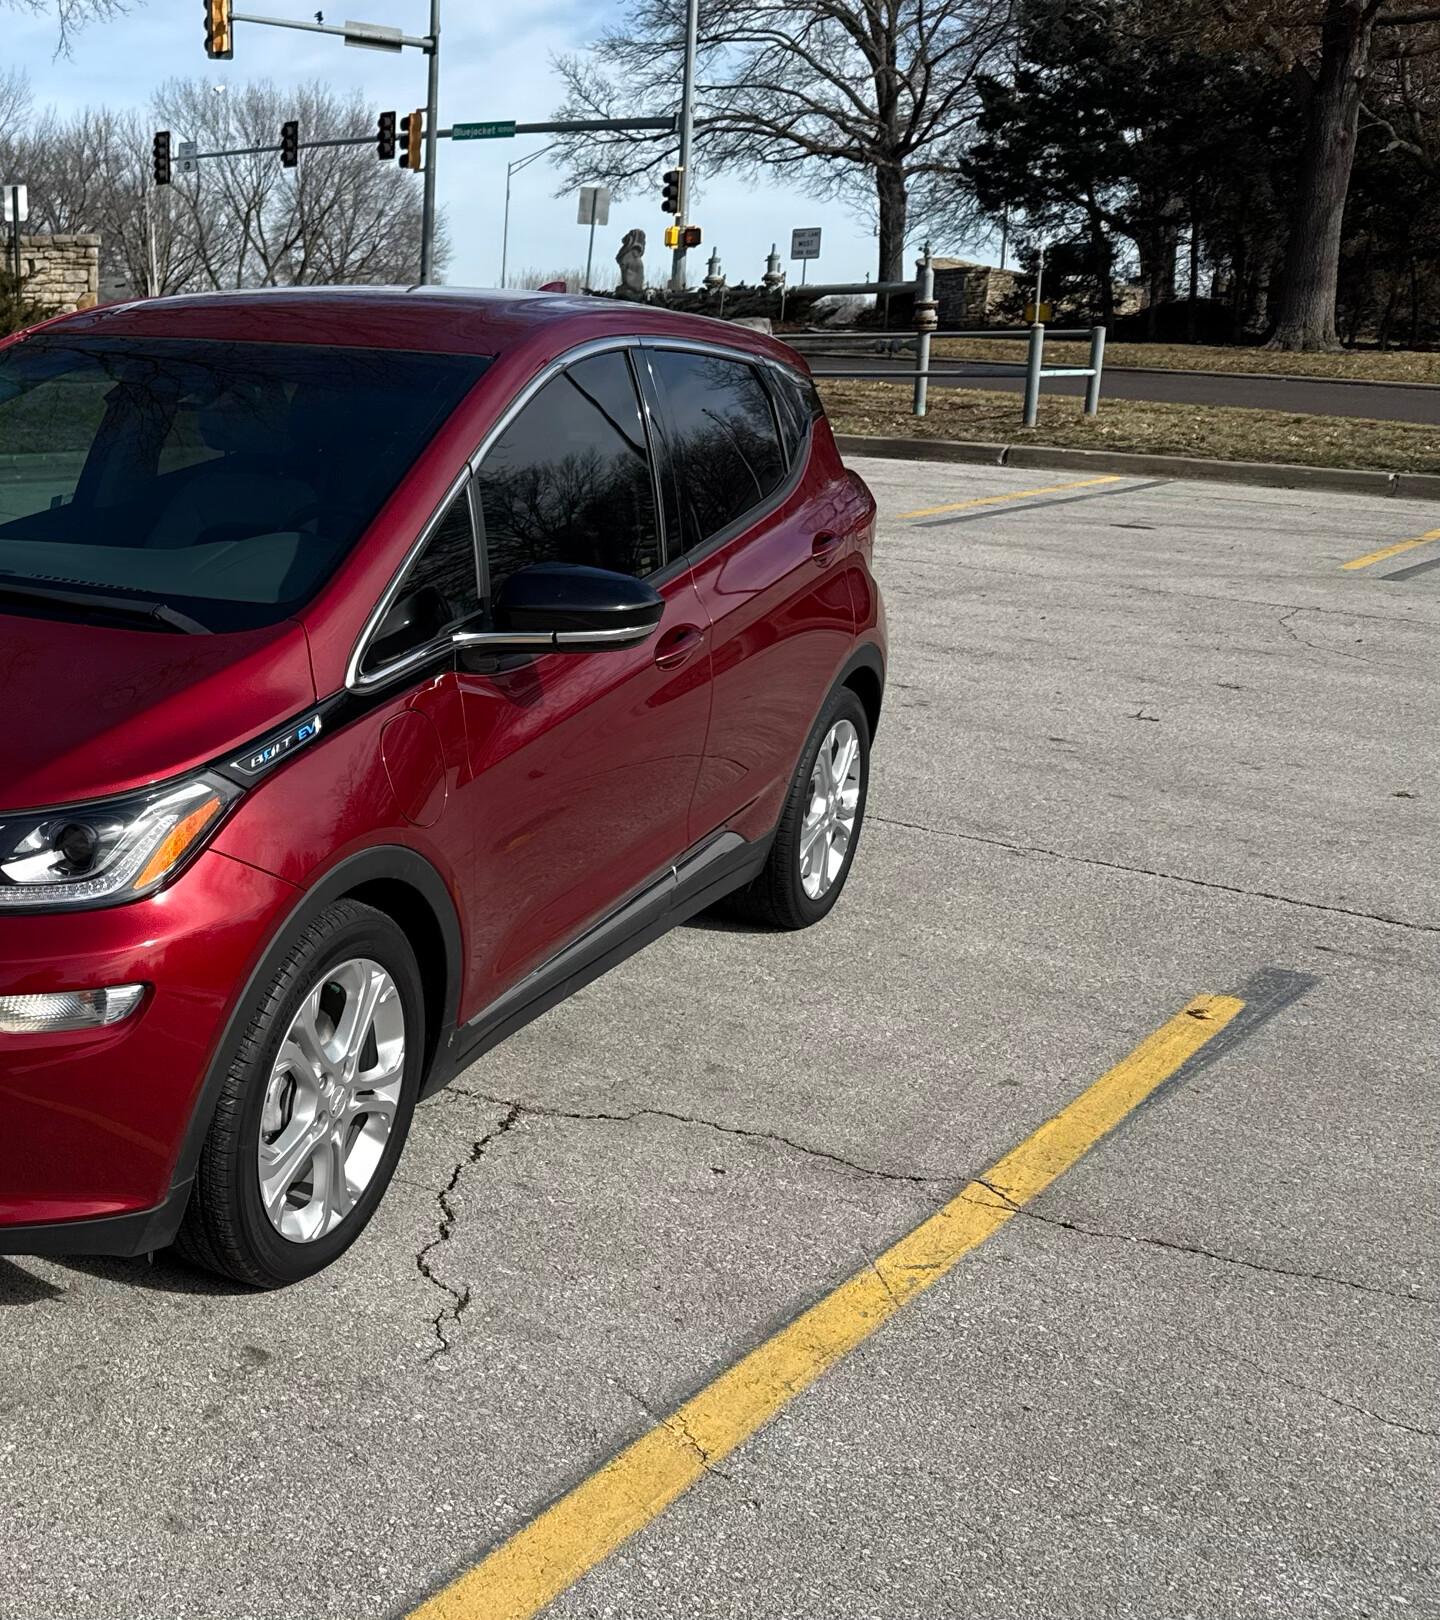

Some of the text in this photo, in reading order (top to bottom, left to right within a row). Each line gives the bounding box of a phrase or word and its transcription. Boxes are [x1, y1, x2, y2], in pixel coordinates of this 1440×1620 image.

[453, 126, 496, 138] Bluejacket
[250, 721, 316, 768] BOLT EV
